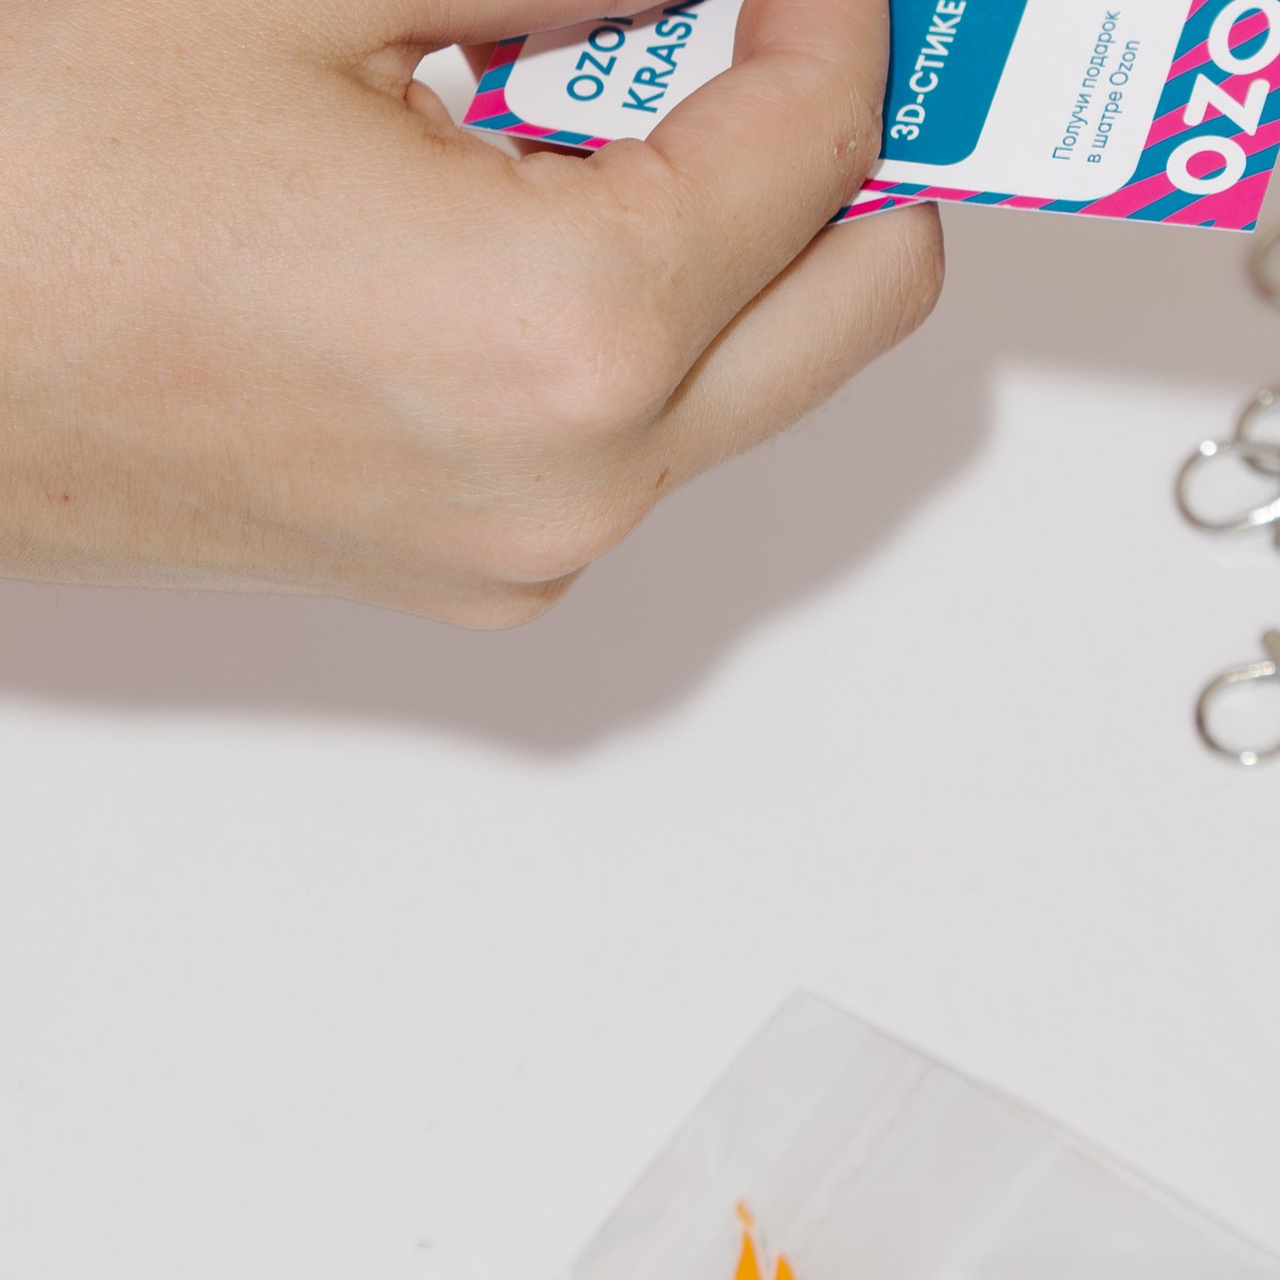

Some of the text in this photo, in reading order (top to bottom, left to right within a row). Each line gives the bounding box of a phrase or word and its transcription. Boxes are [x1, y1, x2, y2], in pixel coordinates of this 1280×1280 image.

[1052, 10, 1121, 160] Получи подарок
[1087, 40, 1141, 164] в шатре Ozon
